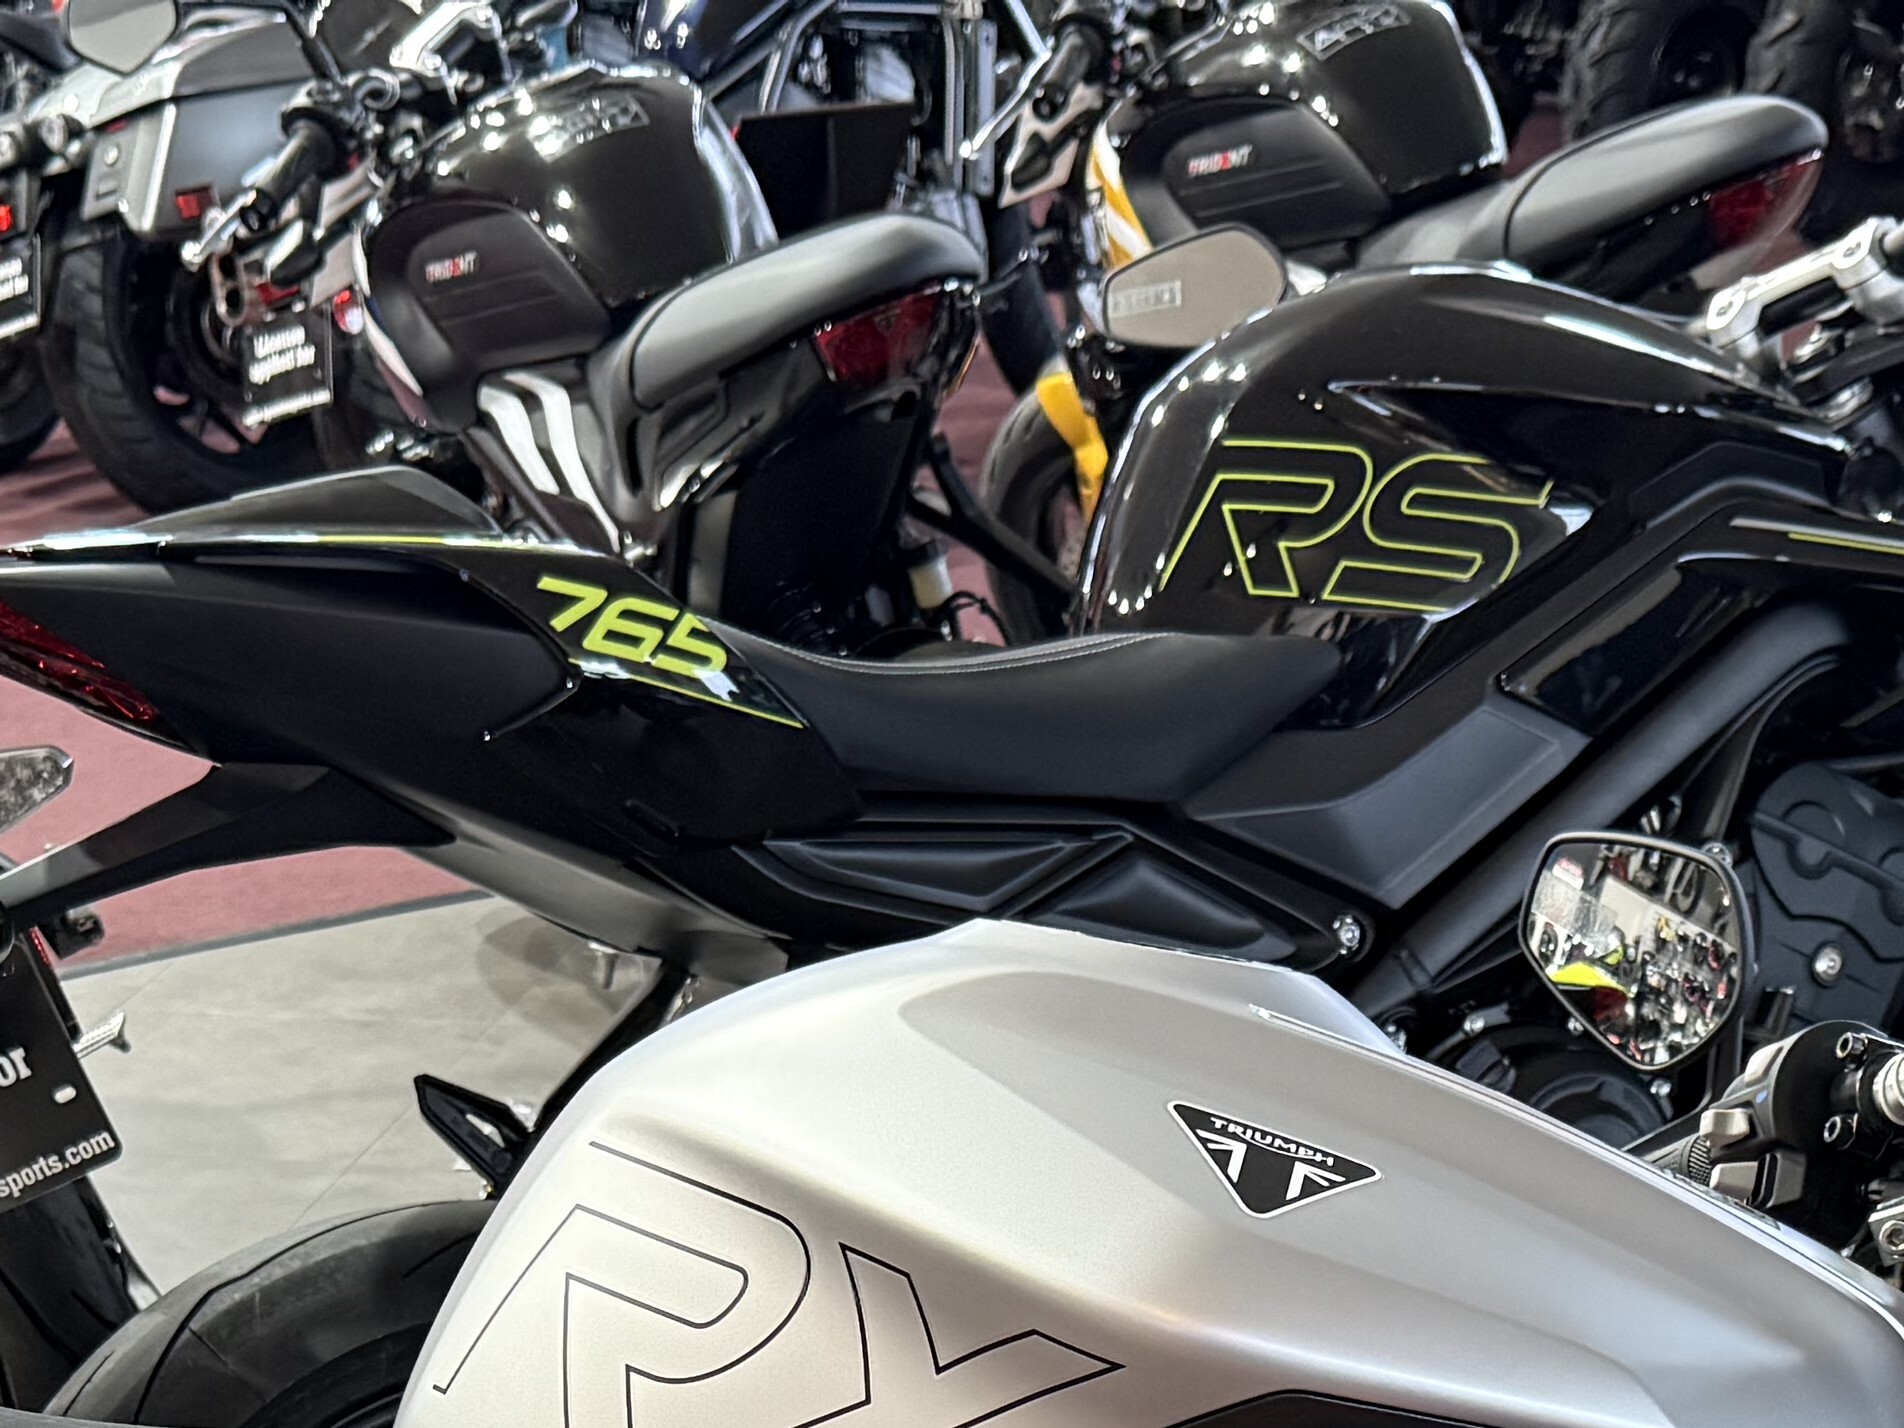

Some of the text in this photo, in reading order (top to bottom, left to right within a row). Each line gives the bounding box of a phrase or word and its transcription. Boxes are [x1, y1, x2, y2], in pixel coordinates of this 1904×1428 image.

[1159, 440, 1554, 612] RS
[537, 576, 727, 673] 765
[1210, 1114, 1336, 1168] TRIUMPH
